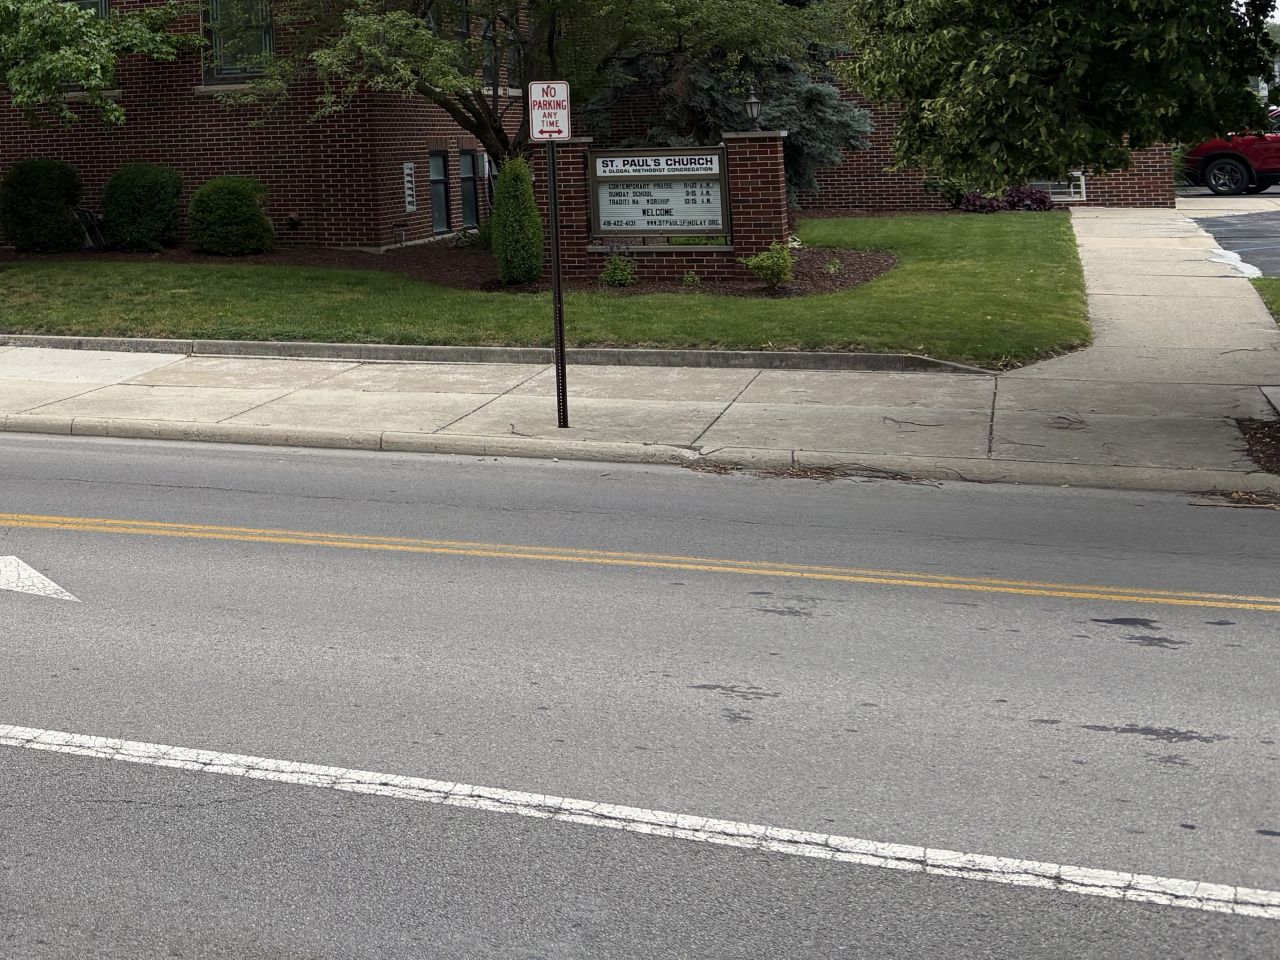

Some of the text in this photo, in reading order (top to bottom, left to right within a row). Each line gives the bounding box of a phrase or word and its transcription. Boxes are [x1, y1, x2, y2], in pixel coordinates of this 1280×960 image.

[542, 87, 556, 97] NO
[533, 100, 566, 110] PARKING
[602, 158, 713, 168] ST. PAUL'S CHURCH
[642, 208, 674, 216] WELCOME
